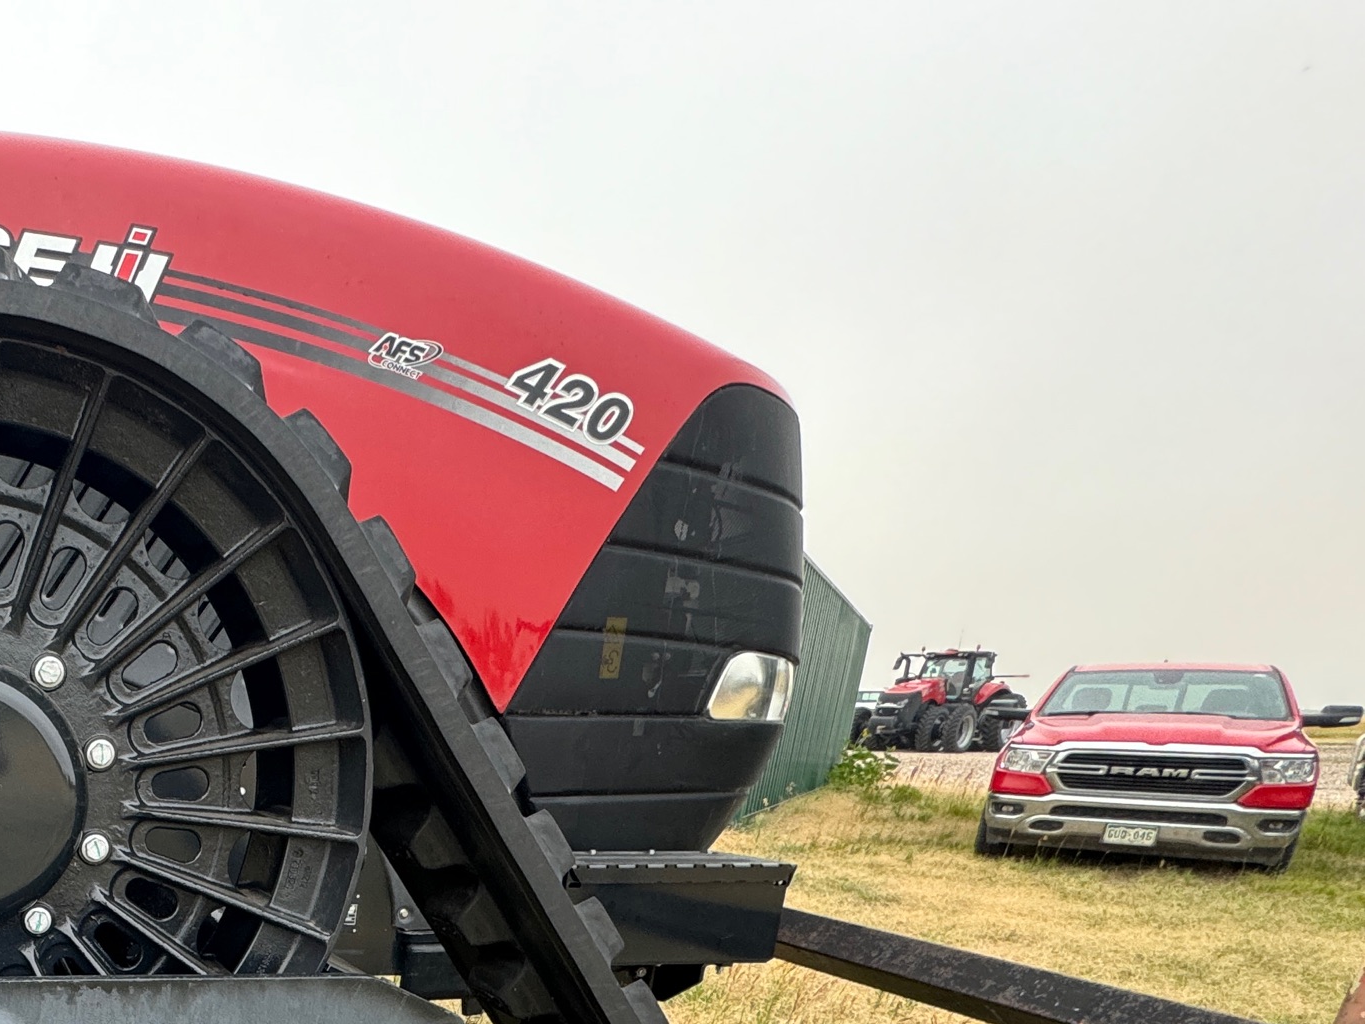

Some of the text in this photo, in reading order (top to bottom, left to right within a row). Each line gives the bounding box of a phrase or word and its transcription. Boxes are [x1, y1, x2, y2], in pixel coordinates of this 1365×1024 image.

[369, 332, 430, 364] AFS
[381, 360, 421, 379] CONNECT
[504, 357, 634, 445] 420
[1109, 766, 1190, 778] RAM
